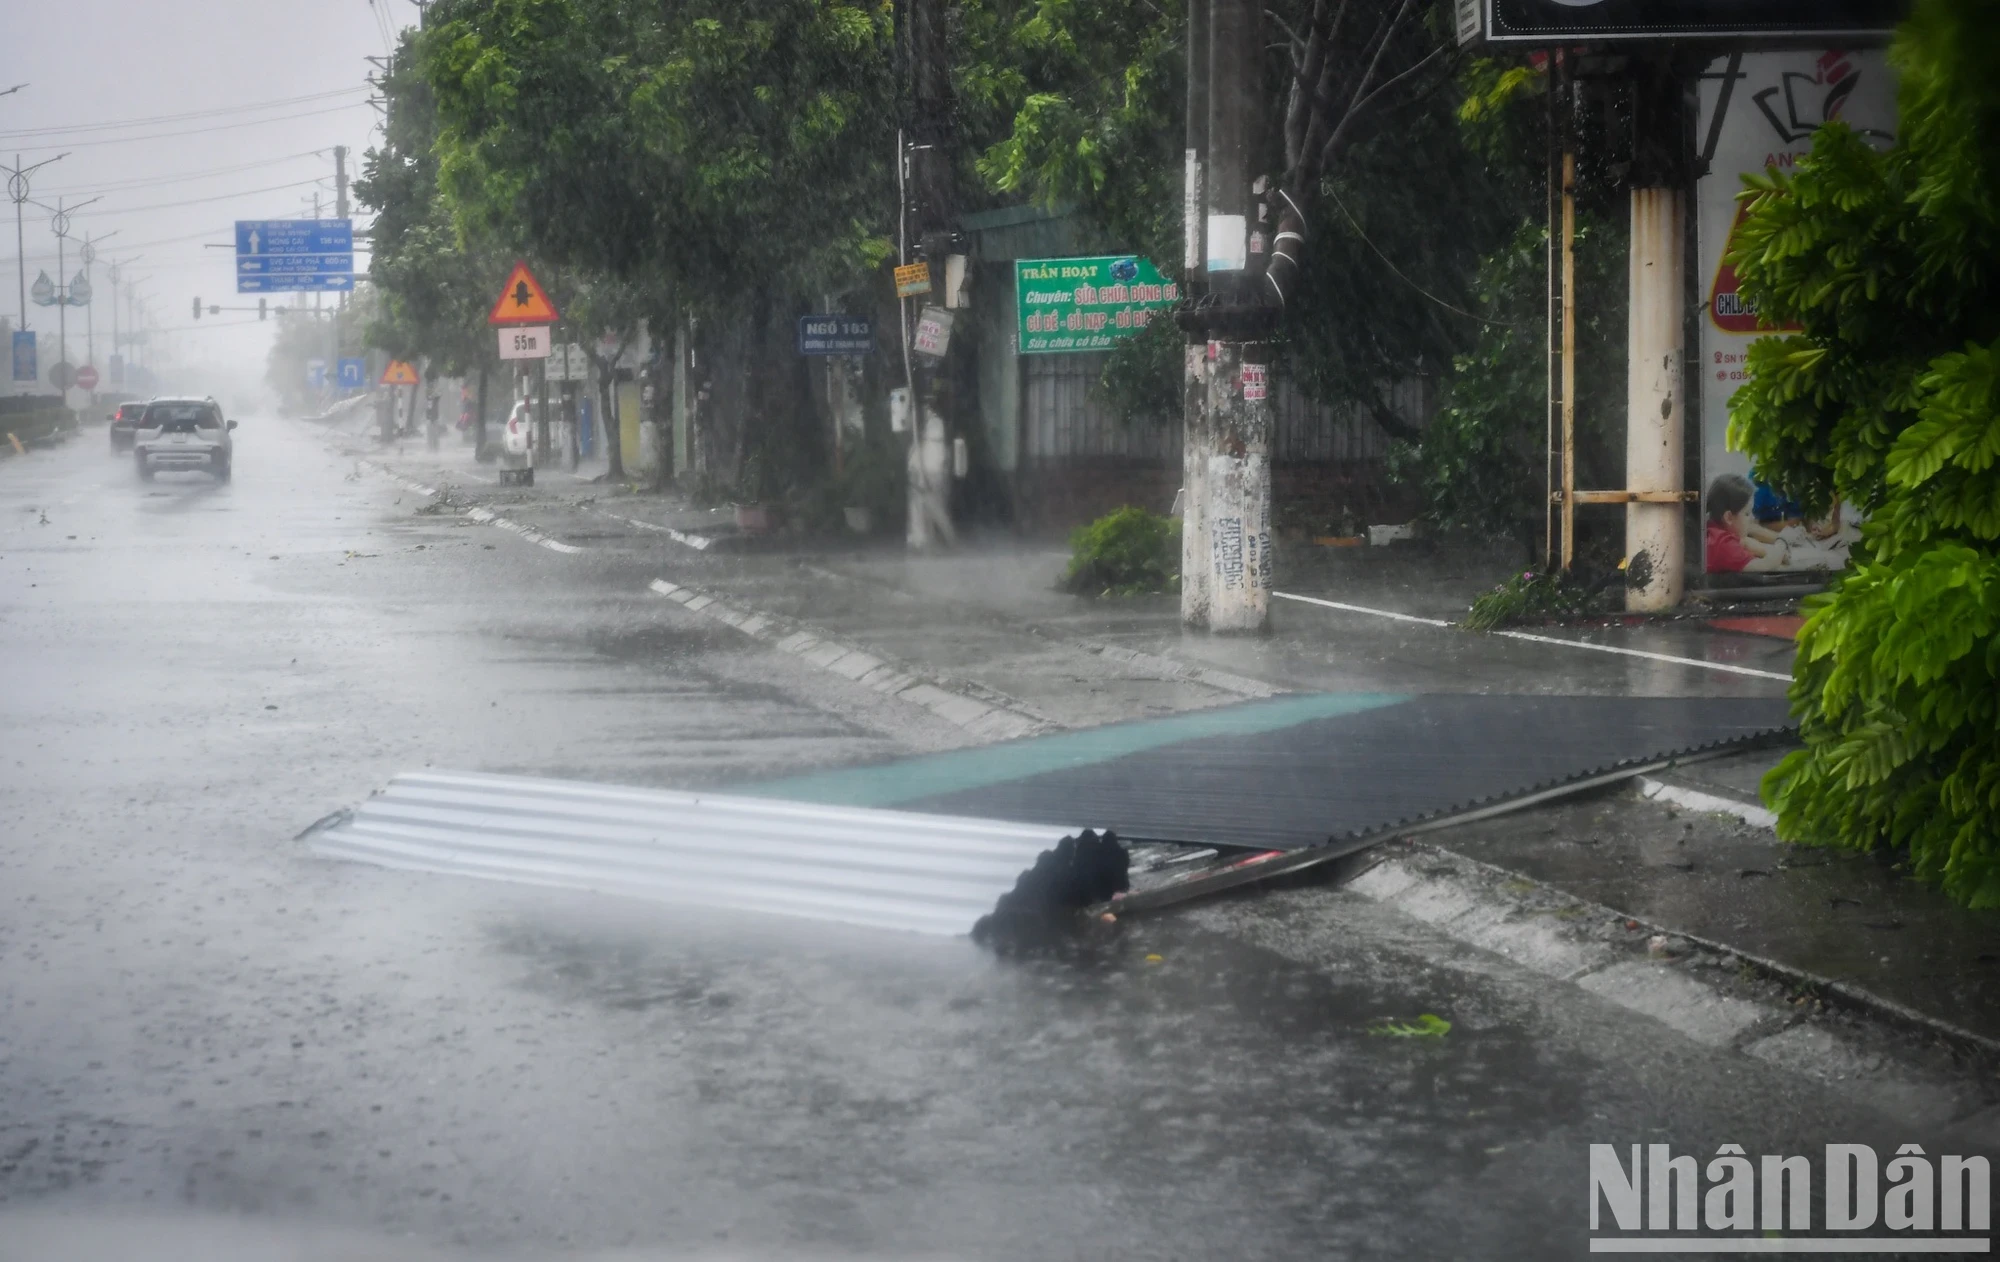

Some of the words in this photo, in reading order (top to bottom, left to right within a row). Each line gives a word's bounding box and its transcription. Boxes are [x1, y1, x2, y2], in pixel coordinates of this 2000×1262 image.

[1062, 265, 1098, 279] HOẠT
[1026, 291, 1072, 304] Chuyên:
[1099, 284, 1129, 304] CHỮA
[1131, 282, 1162, 306] ĐỘNG
[1084, 312, 1107, 332] NẠP
[514, 335, 537, 351] 55m
[1730, 371, 1752, 380] 039
